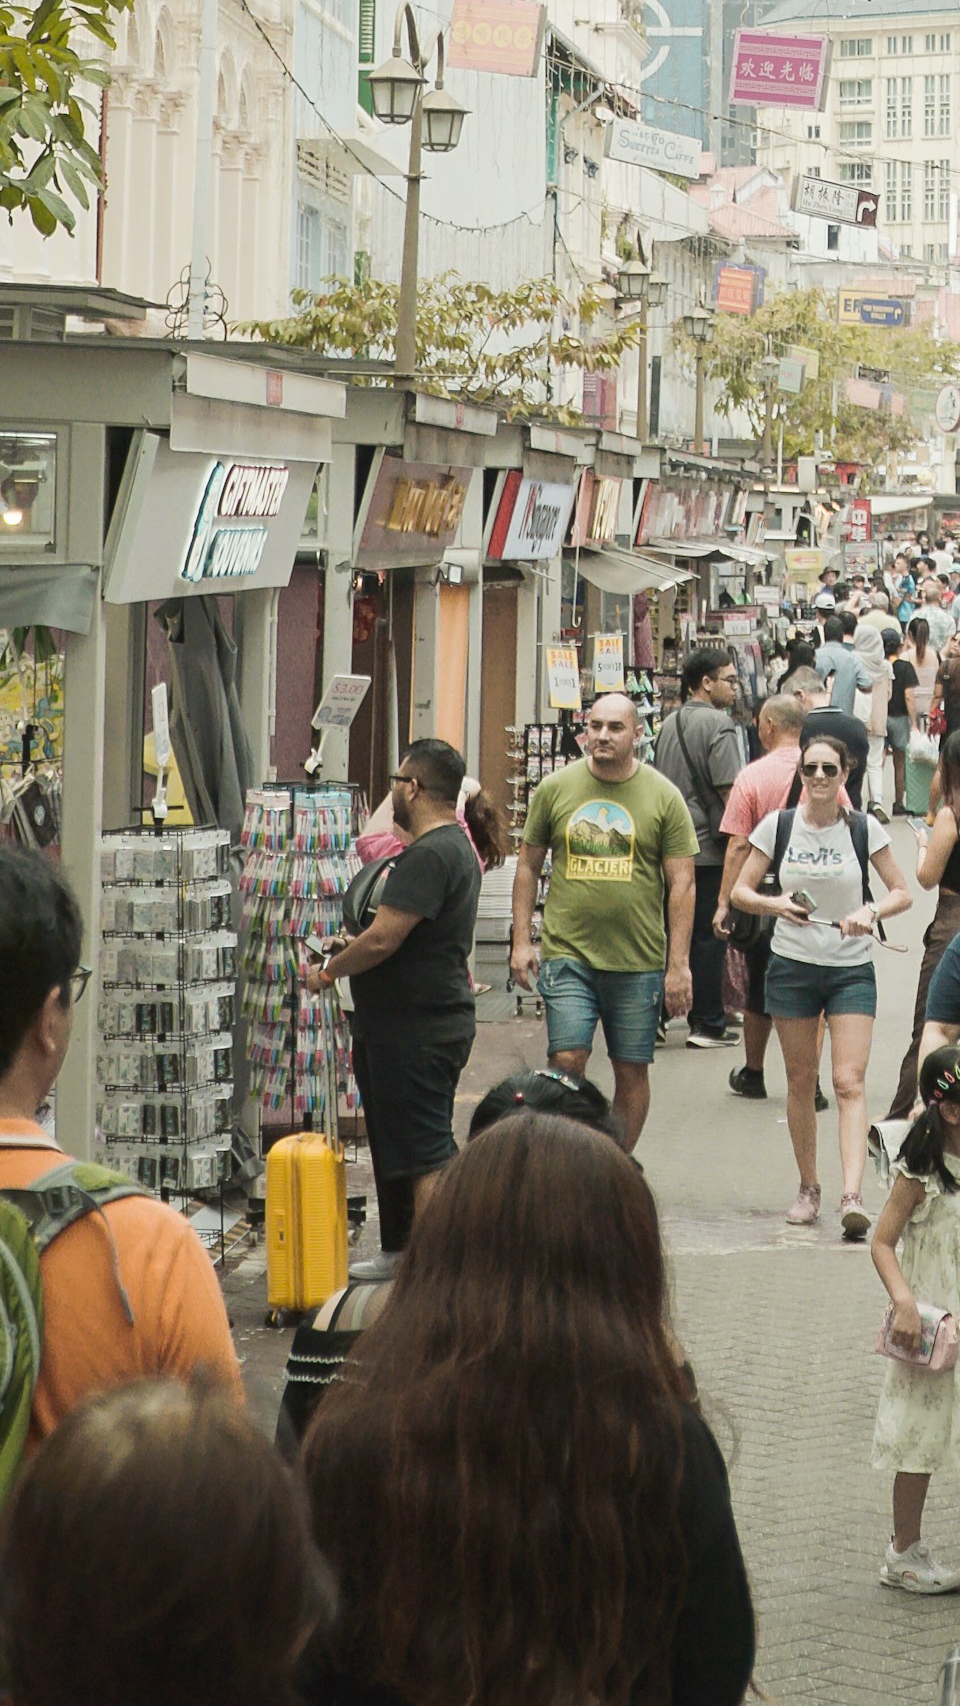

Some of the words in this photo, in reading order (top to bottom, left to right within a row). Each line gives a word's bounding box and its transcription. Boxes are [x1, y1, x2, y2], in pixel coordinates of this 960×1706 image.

[740, 58, 815, 82] 欢迎光临
[217, 463, 289, 517] GIFTMASTER
[206, 527, 268, 578] SOUVENIRS
[599, 638, 620, 648] SALE
[551, 651, 573, 661] SALE
[332, 682, 363, 694] $3.00
[787, 846, 842, 866] Levi's
[570, 857, 628, 874] GLACIER
